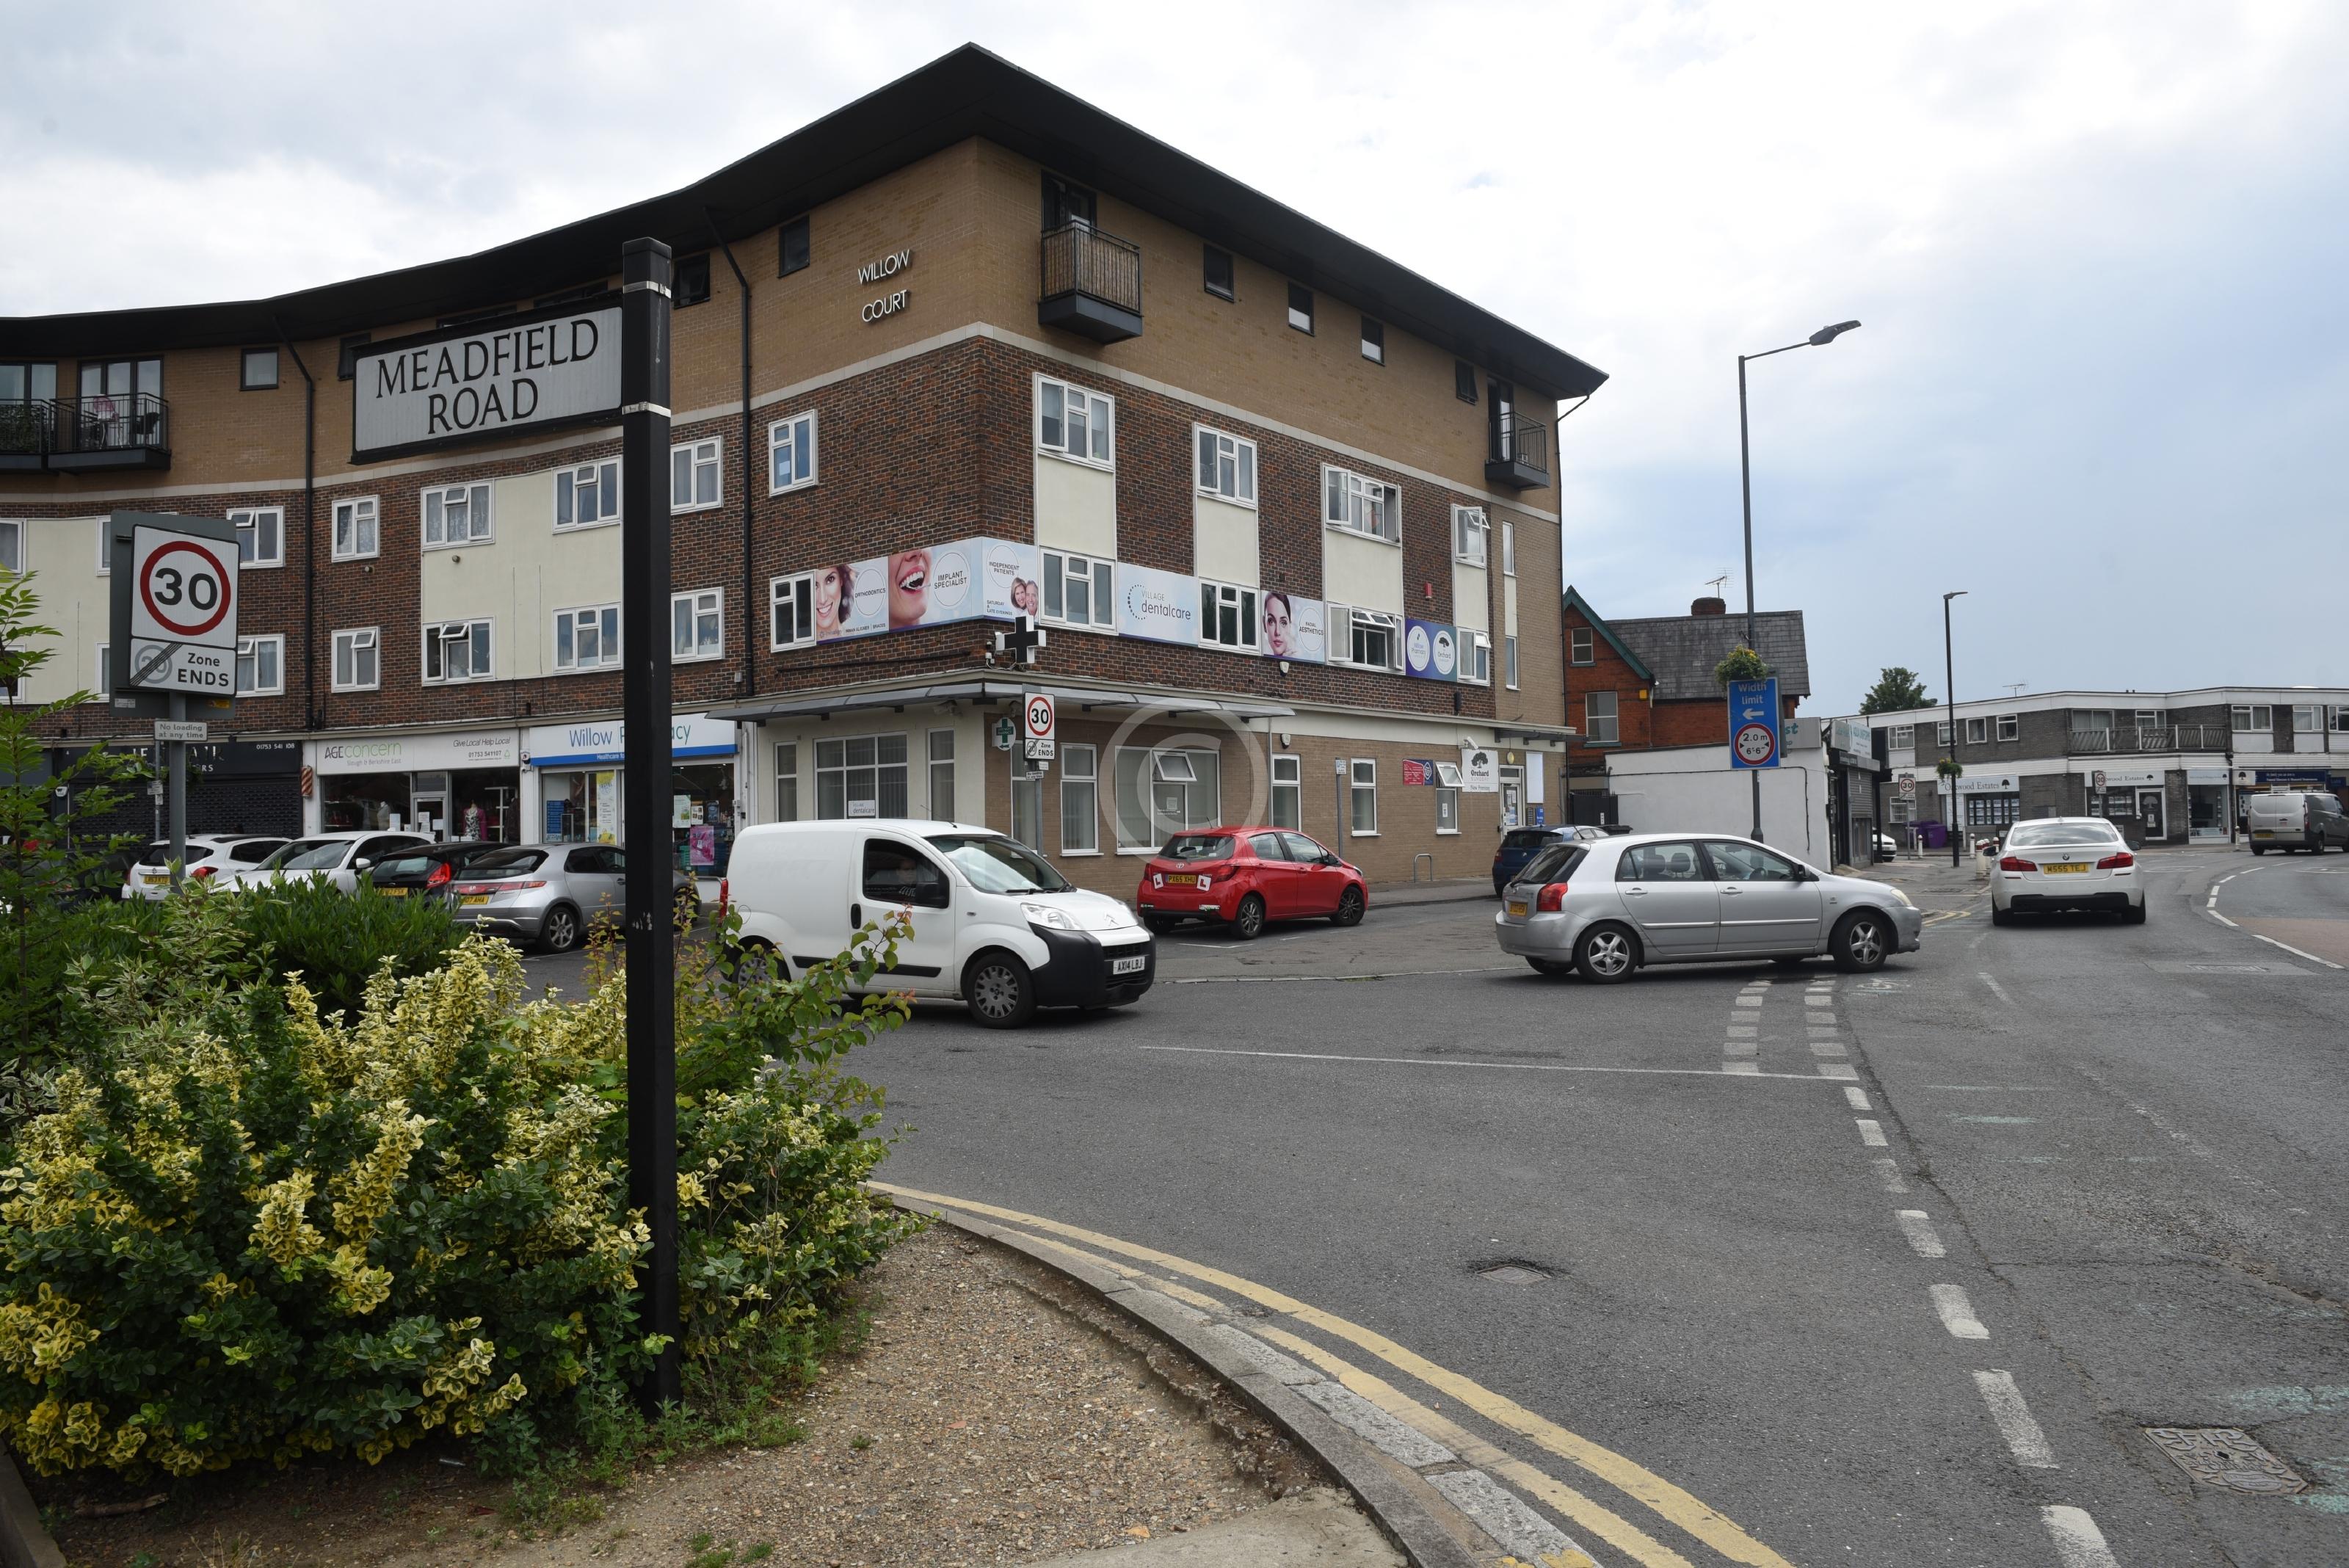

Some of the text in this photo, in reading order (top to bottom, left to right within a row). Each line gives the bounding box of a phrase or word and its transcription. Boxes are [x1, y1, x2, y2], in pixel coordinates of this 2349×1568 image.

[857, 249, 910, 285] WILLOW
[862, 289, 907, 322] COURT
[376, 319, 598, 399] MEADFIELD
[428, 377, 538, 435] ROAD
[989, 561, 1020, 570] INDEPENDENT
[994, 567, 1014, 576] PATIENTS
[937, 570, 963, 581] IMPLANT
[154, 567, 218, 610] 30
[934, 577, 968, 589] SPECIALIST
[854, 587, 886, 599] ORTHODONTICS
[1141, 589, 1165, 601] VILLAGE
[1141, 599, 1191, 620] dentalcare
[1299, 626, 1324, 636] AESTHETICS
[188, 653, 220, 667] Zone
[178, 669, 229, 687] ENDS
[1738, 683, 1767, 692] Width
[1742, 696, 1763, 705] limit
[1031, 708, 1049, 725] 30
[466, 738, 481, 747] Local
[482, 738, 495, 747] Help
[495, 736, 511, 745] Local
[569, 727, 613, 747] Willow
[1743, 733, 1759, 741] 2.0
[1977, 782, 2000, 790] Estates
[1155, 877, 1161, 886] L
[1199, 879, 1207, 888] L
